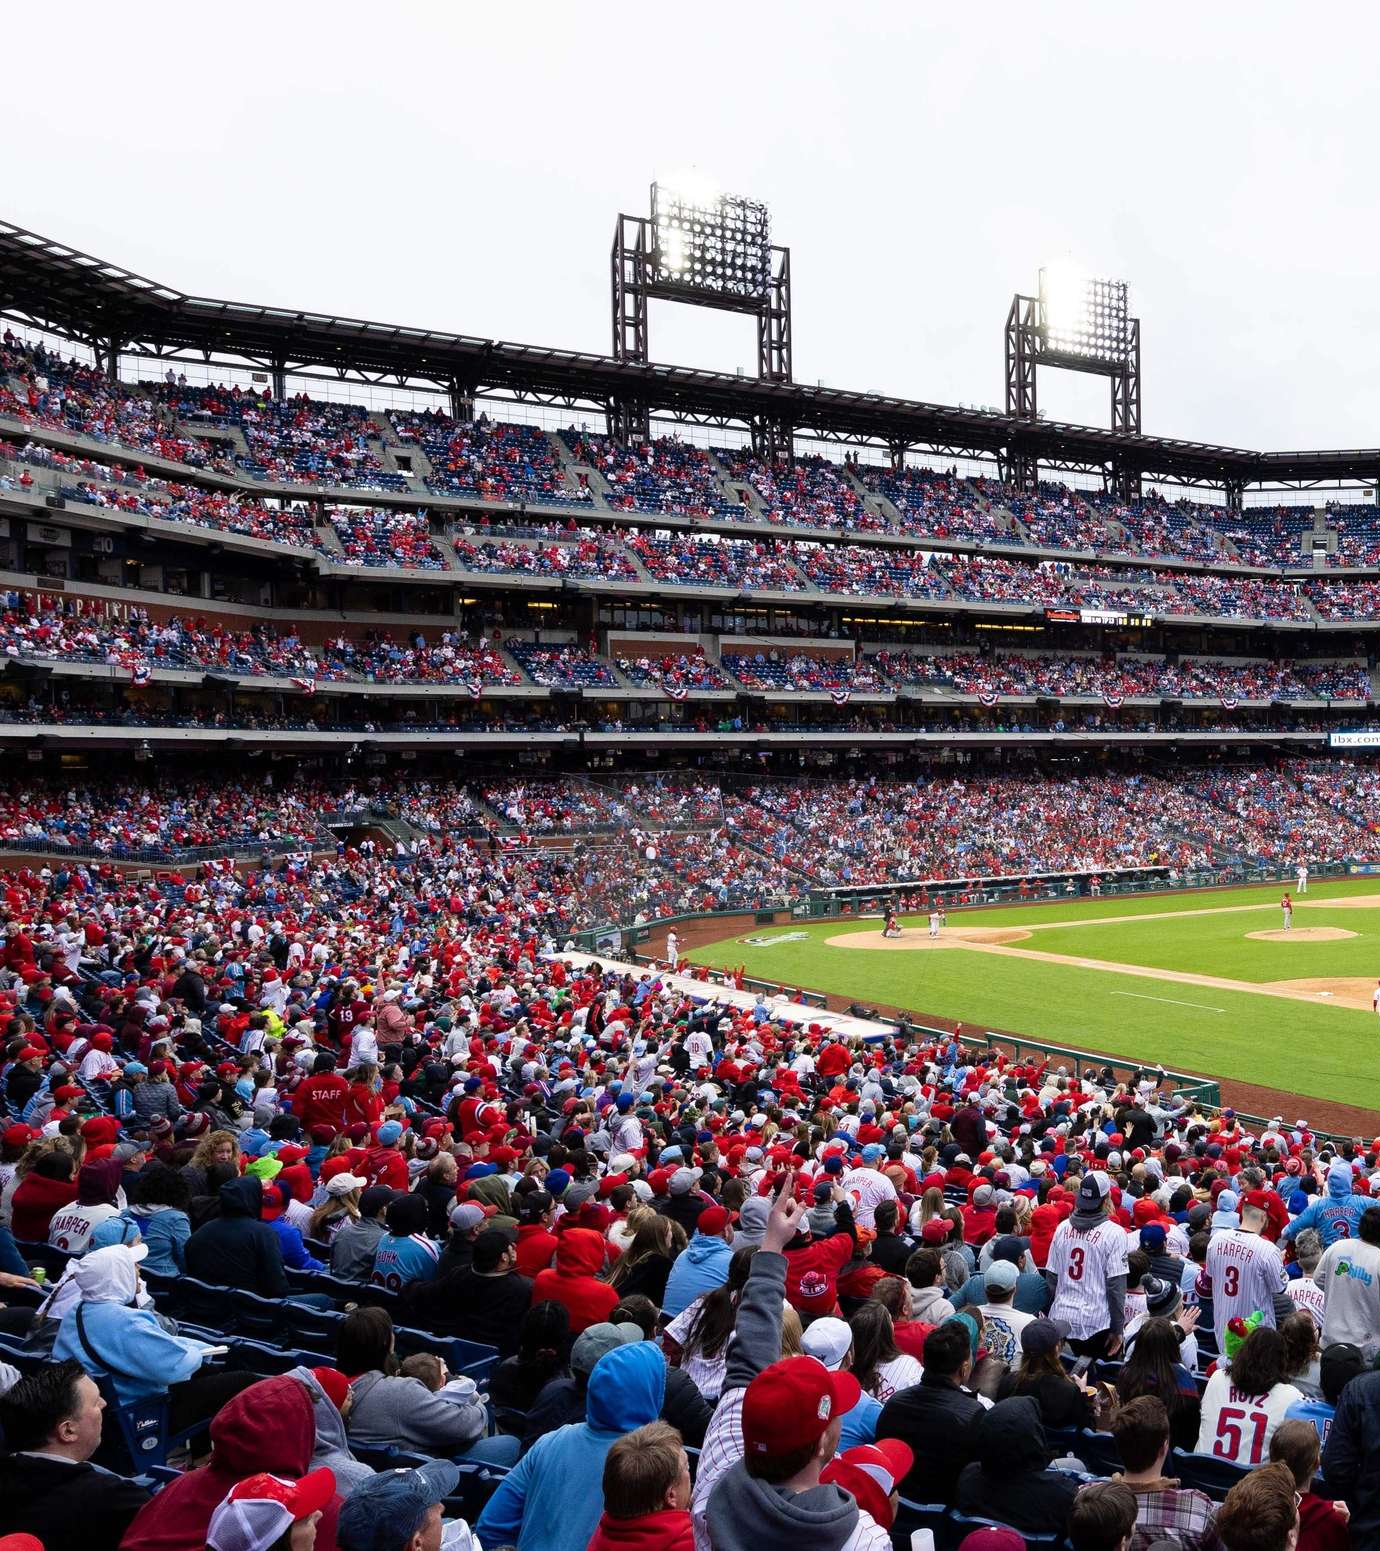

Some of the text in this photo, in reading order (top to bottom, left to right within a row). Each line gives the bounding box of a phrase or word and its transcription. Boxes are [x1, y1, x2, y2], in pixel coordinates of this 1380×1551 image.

[340, 1010, 353, 1022] 19
[312, 1090, 342, 1100] STAFF
[55, 1215, 90, 1236] HARPER
[1332, 1219, 1351, 1241] 3
[1216, 1242, 1254, 1263] HARPER
[1068, 1247, 1085, 1281] 3
[1224, 1265, 1239, 1297] 3
[1213, 1407, 1269, 1464] 51
